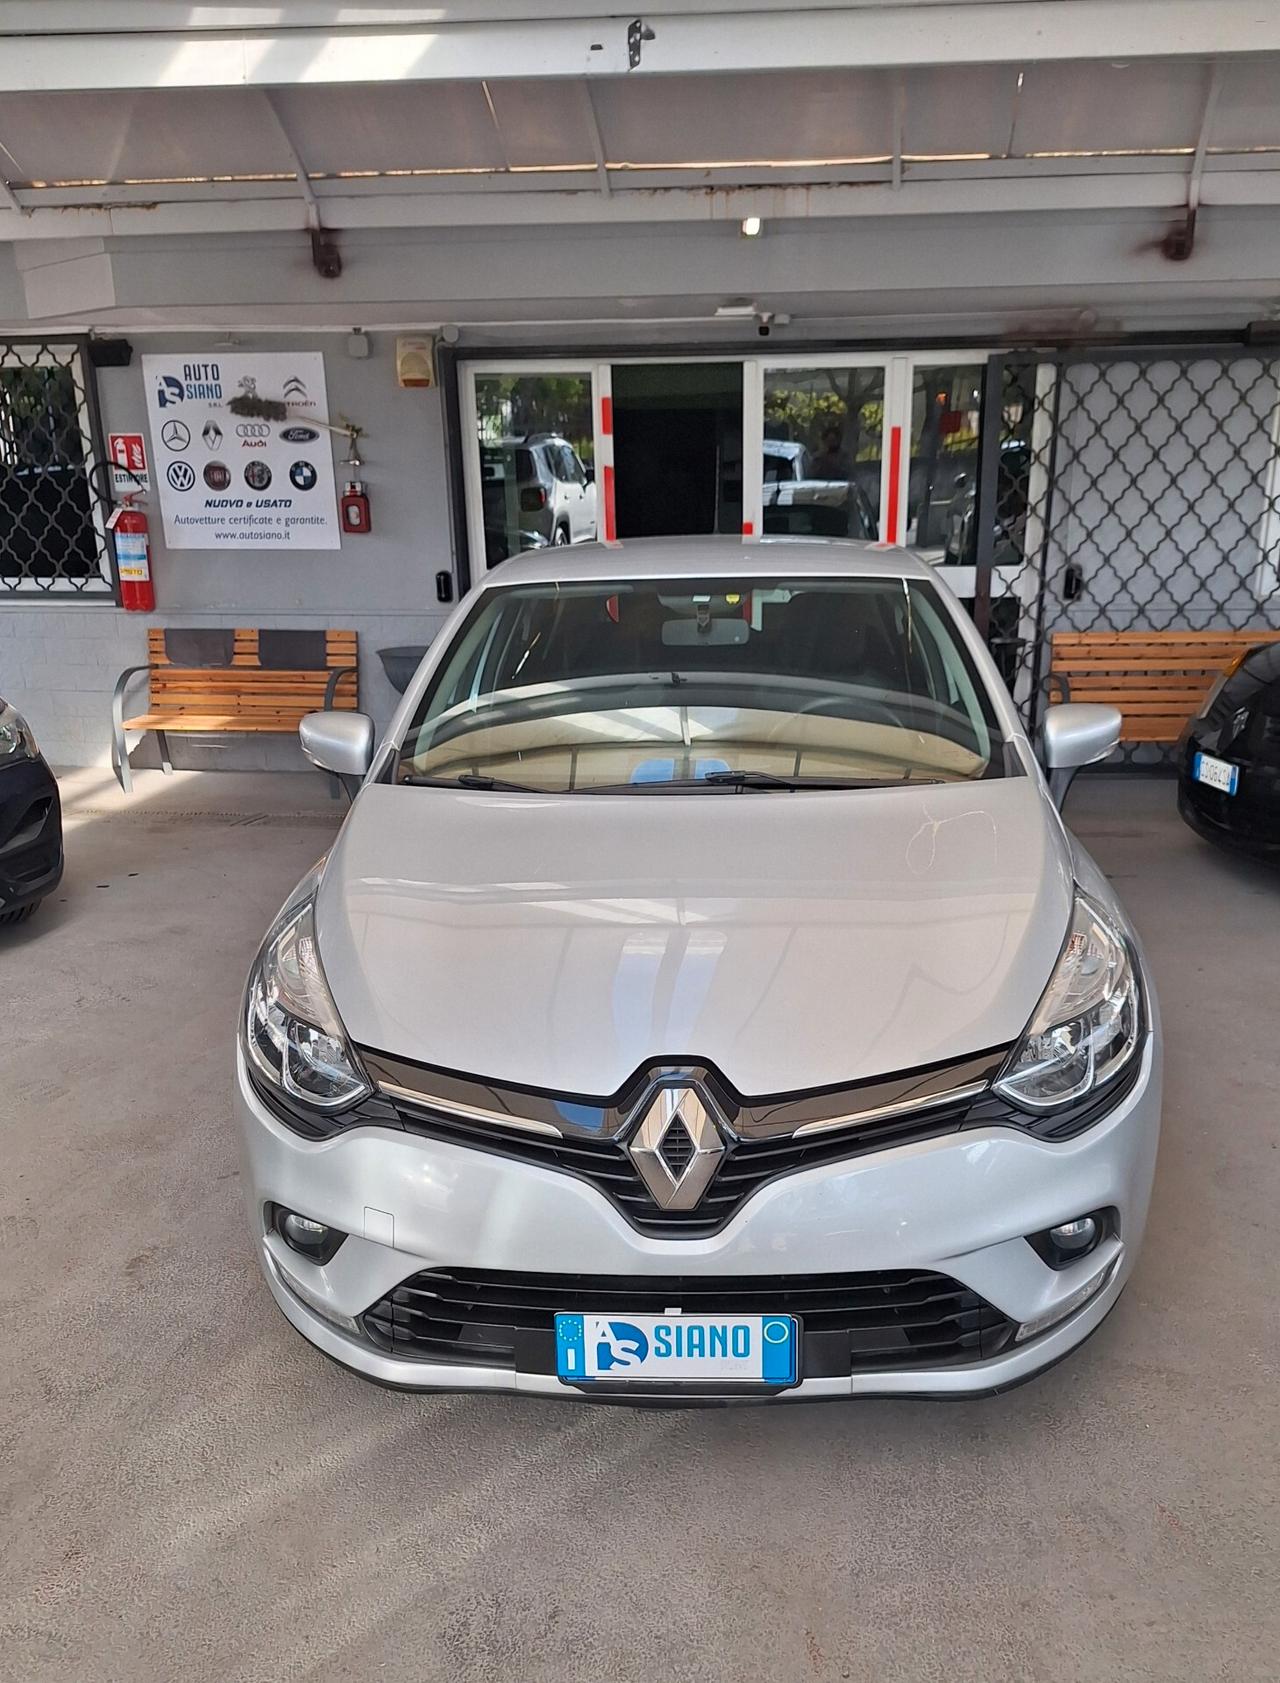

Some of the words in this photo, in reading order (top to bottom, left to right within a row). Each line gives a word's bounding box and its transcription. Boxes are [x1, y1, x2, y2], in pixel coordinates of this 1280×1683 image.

[184, 364, 220, 381] AUTO
[186, 384, 223, 400] SIANO
[242, 440, 267, 448] Audi
[204, 499, 243, 508] NUOVO
[255, 499, 292, 508] USATO
[174, 515, 225, 525] Autovetture
[228, 514, 273, 526] certificate
[276, 517, 281, 525] e
[284, 515, 328, 527] garantite.
[215, 531, 290, 540] www.autosiano.it
[654, 1325, 751, 1358] SIANO
